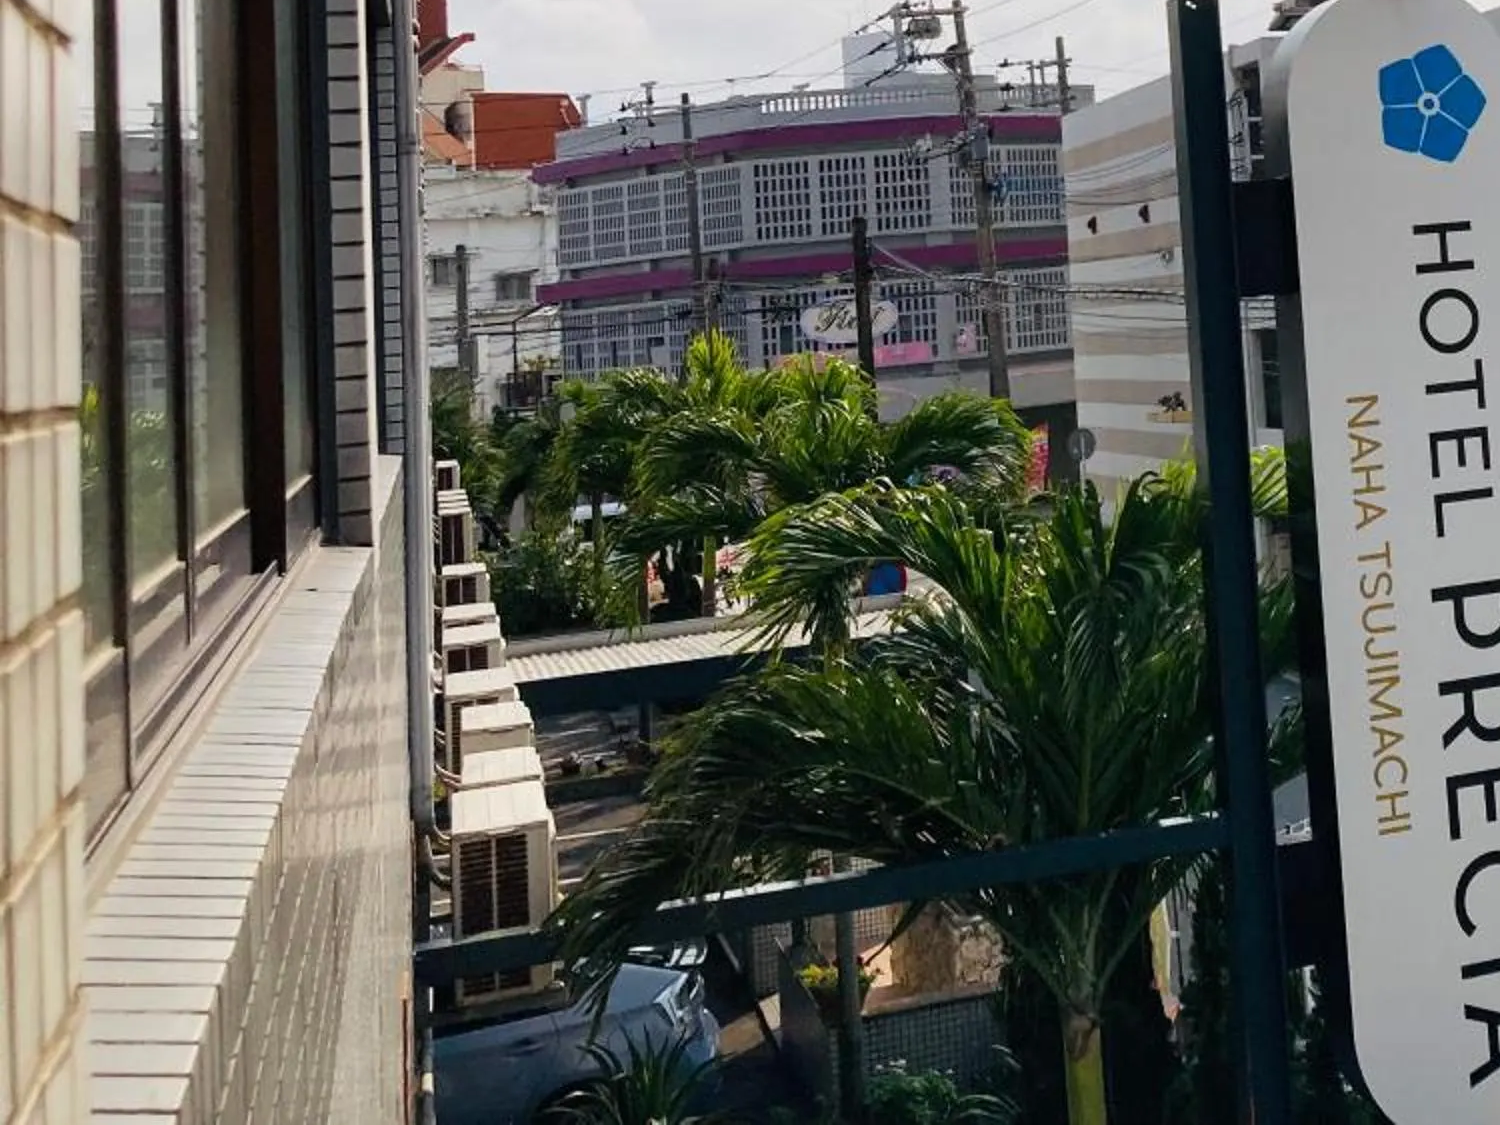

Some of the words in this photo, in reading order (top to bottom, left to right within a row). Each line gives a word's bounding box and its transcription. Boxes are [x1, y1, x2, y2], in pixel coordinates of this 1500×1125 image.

[1345, 394, 1388, 532] NAHA
[1412, 219, 1494, 538] HOTEL
[1356, 540, 1413, 837] TSUJIMACHI
